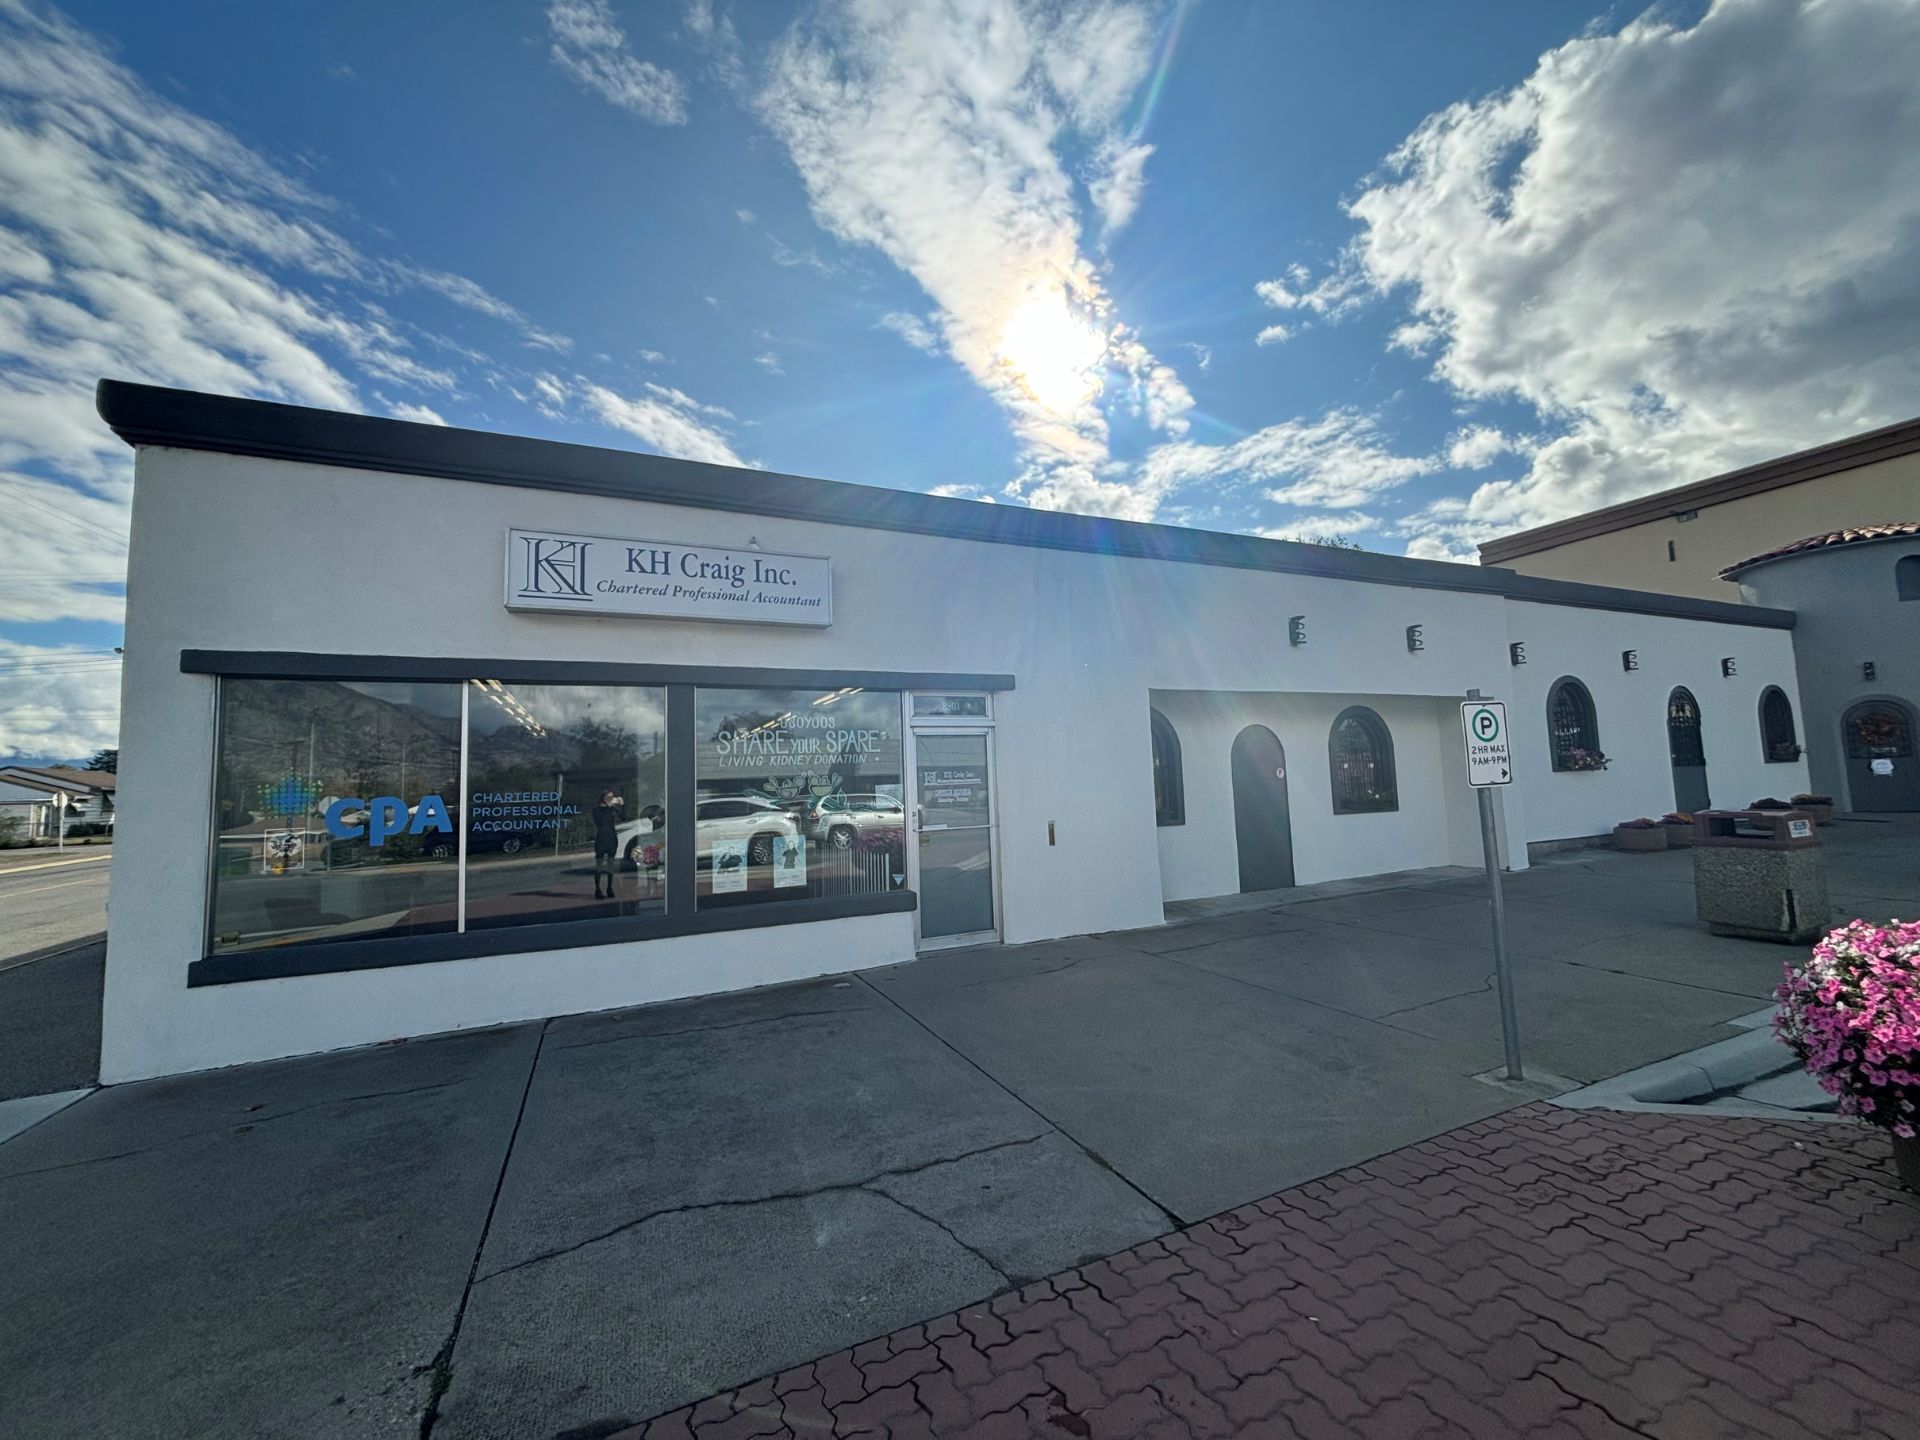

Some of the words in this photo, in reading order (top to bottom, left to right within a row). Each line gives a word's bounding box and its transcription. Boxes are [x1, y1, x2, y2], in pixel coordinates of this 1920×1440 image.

[625, 547, 672, 576] KH
[680, 552, 746, 589] Craig
[752, 559, 797, 586] Inc.
[596, 579, 670, 598] Chartered
[672, 585, 750, 603] Professional
[751, 591, 822, 608] Accountant
[1480, 717, 1492, 735] P
[716, 729, 789, 755] SHARE
[790, 737, 822, 754] YOUR
[825, 729, 881, 753] SPARE
[1490, 745, 1505, 753] MAX
[718, 755, 765, 768] LIVING
[768, 754, 812, 767] KIDNEY
[814, 753, 867, 765] DONATION
[472, 791, 560, 803] CHARTERED
[472, 805, 582, 817] PROFESSIONAL
[471, 818, 570, 832] ACCOUNTANT
